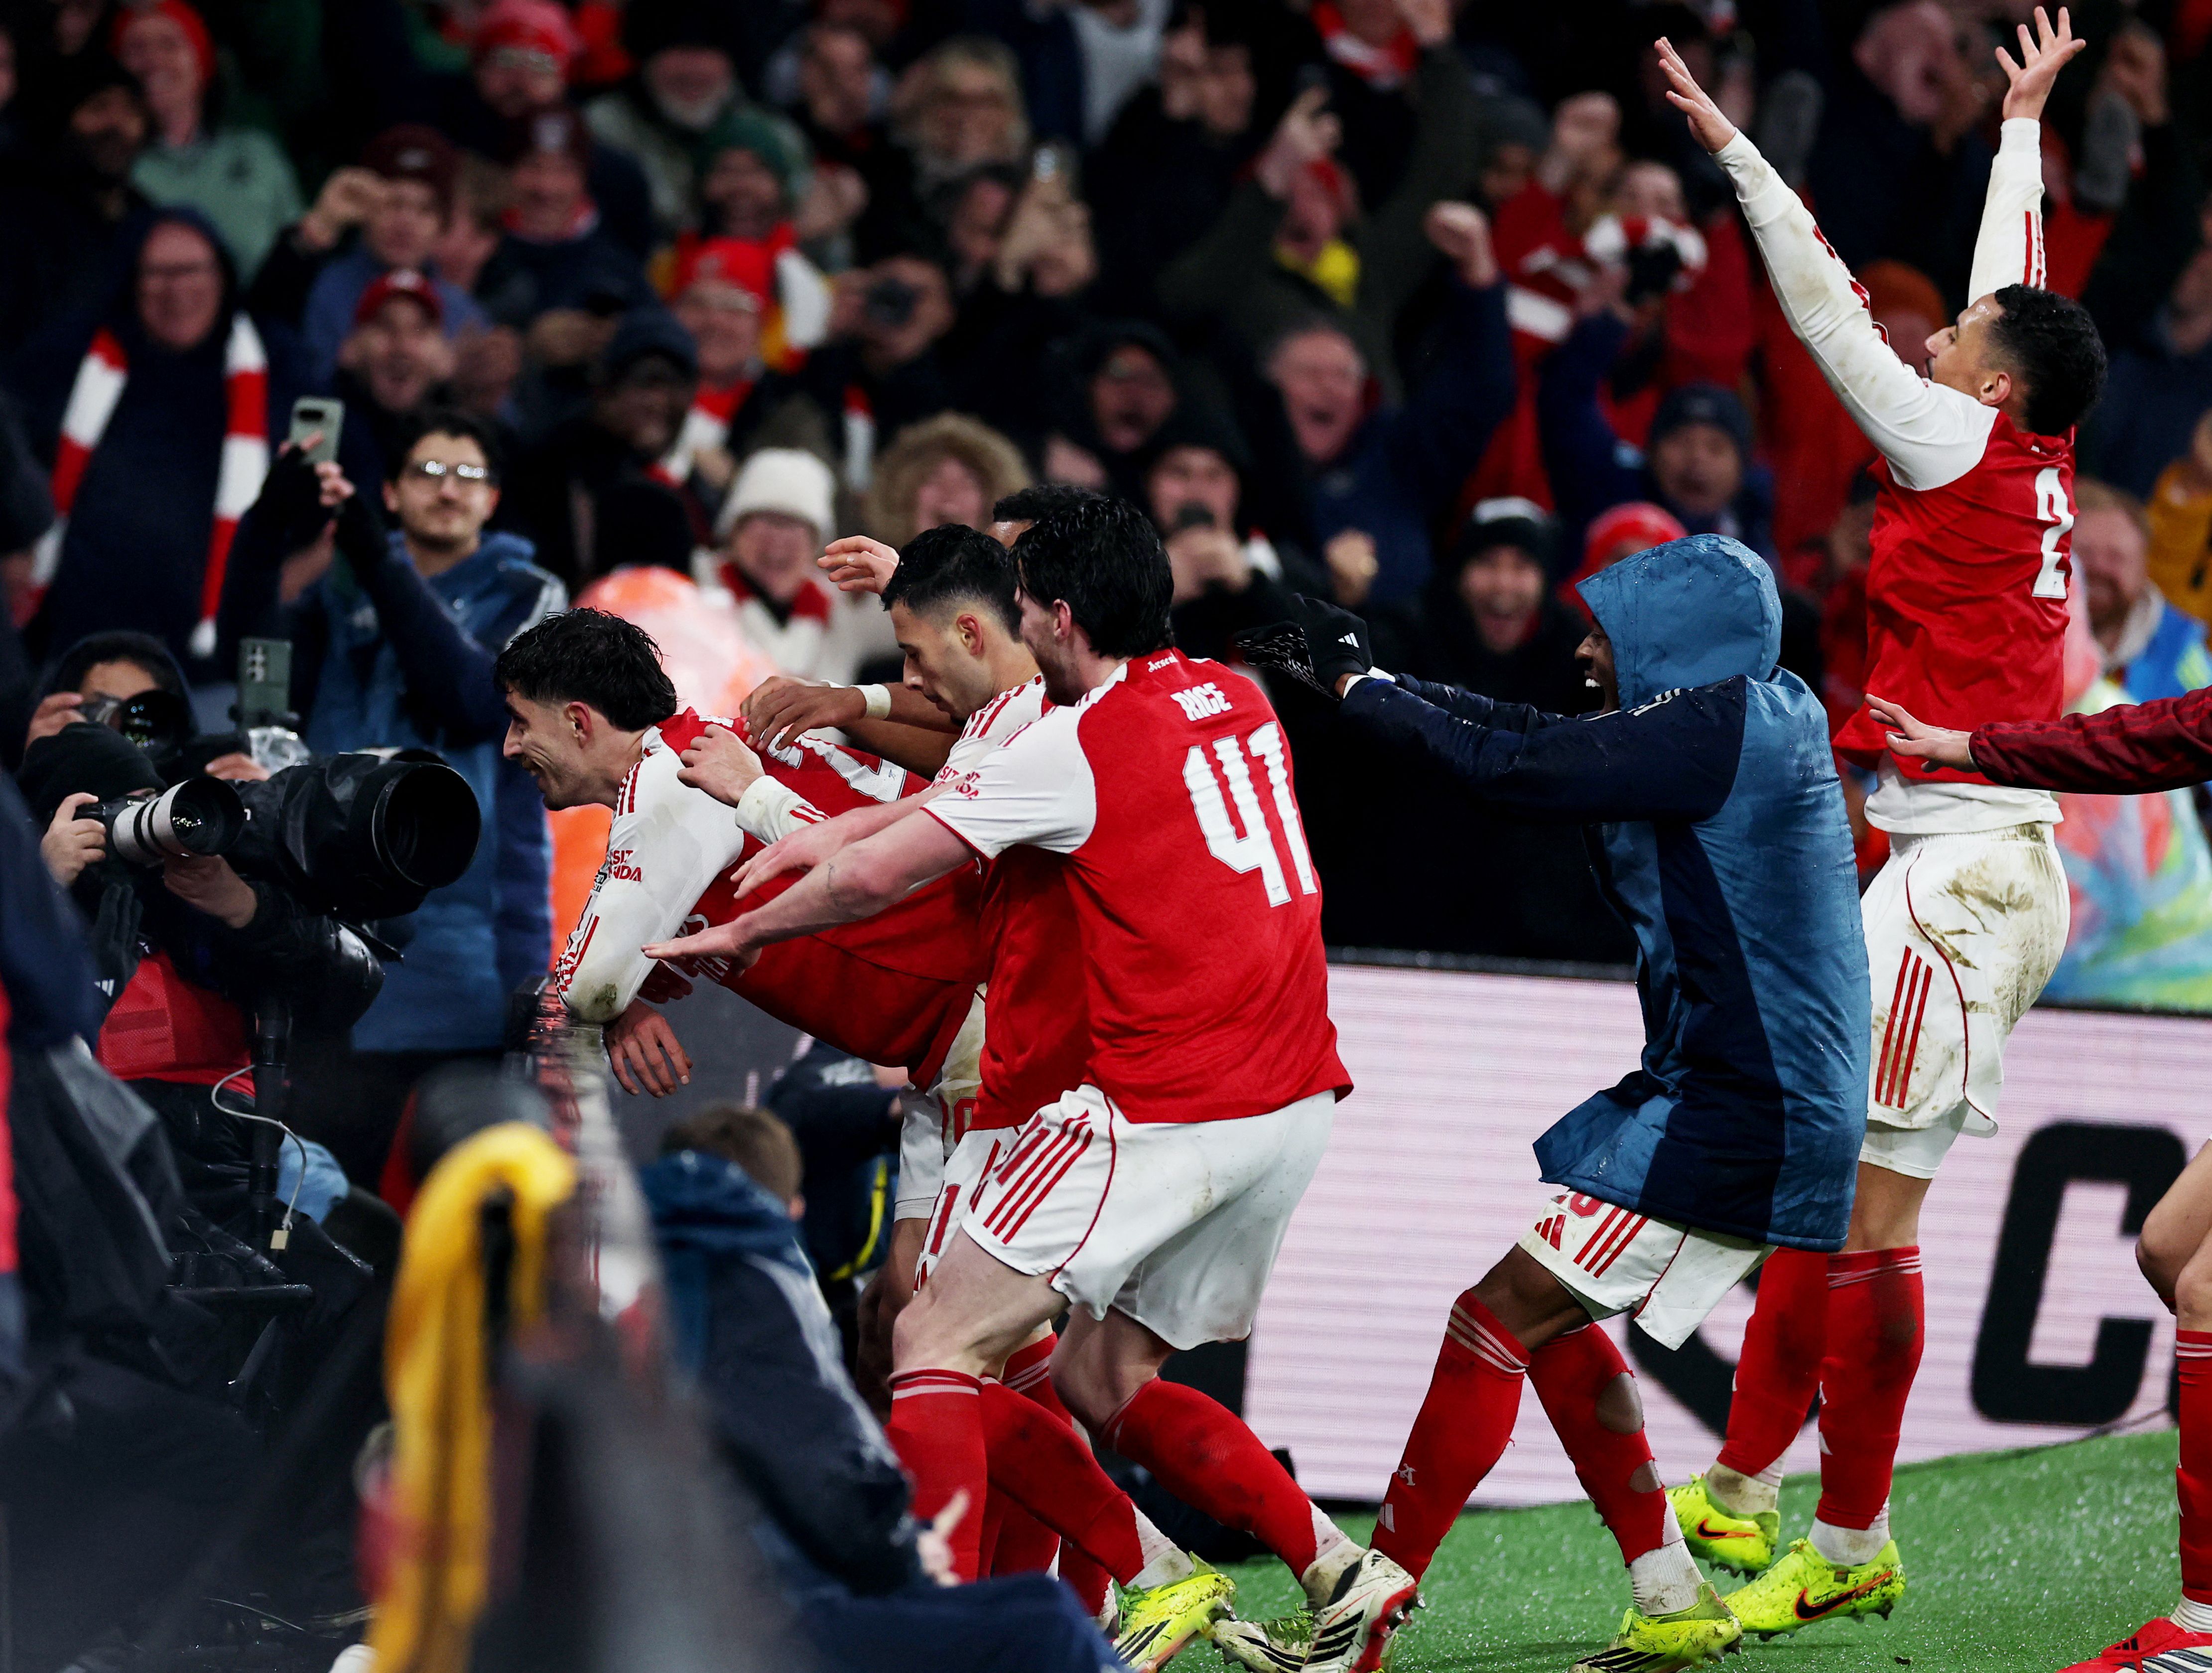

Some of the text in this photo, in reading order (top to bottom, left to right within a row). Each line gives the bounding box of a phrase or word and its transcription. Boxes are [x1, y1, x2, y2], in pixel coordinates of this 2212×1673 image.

[2032, 467, 2075, 599] 2
[1170, 682, 1233, 721] RICE
[1182, 721, 1318, 908] 41
[1971, 1120, 2187, 1425] C
